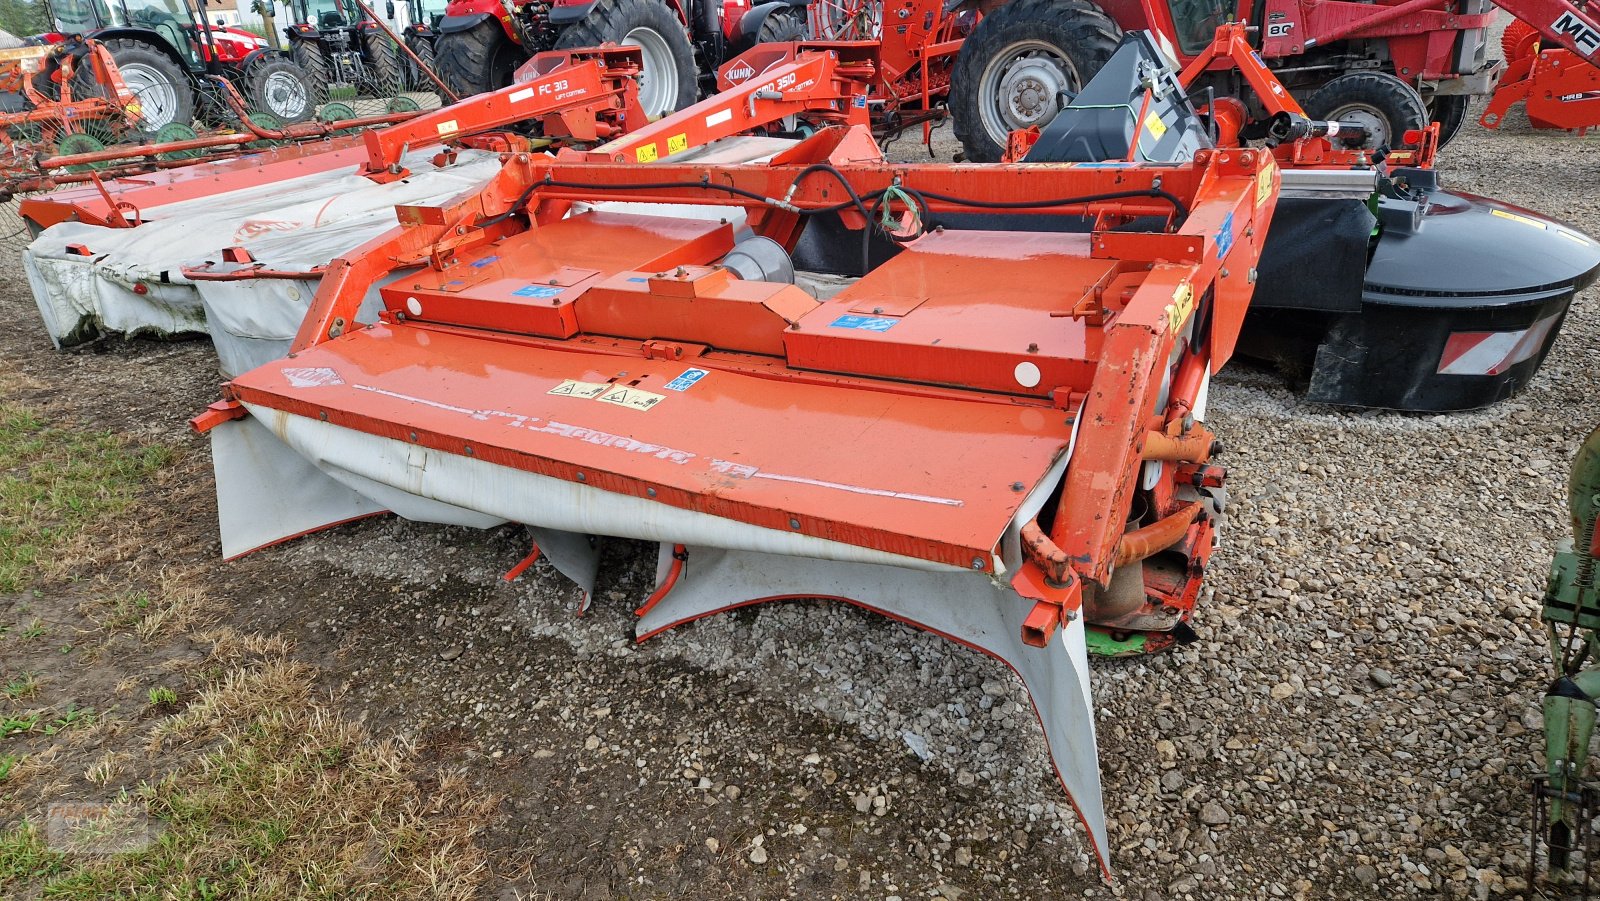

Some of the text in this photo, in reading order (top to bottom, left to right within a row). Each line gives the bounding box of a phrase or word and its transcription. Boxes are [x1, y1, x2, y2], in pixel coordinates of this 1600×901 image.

[1556, 14, 1600, 49] MF
[728, 67, 751, 79] KUHN
[539, 80, 568, 96] FC 313
[776, 73, 796, 91] 3510
[1562, 92, 1583, 101] HRB
